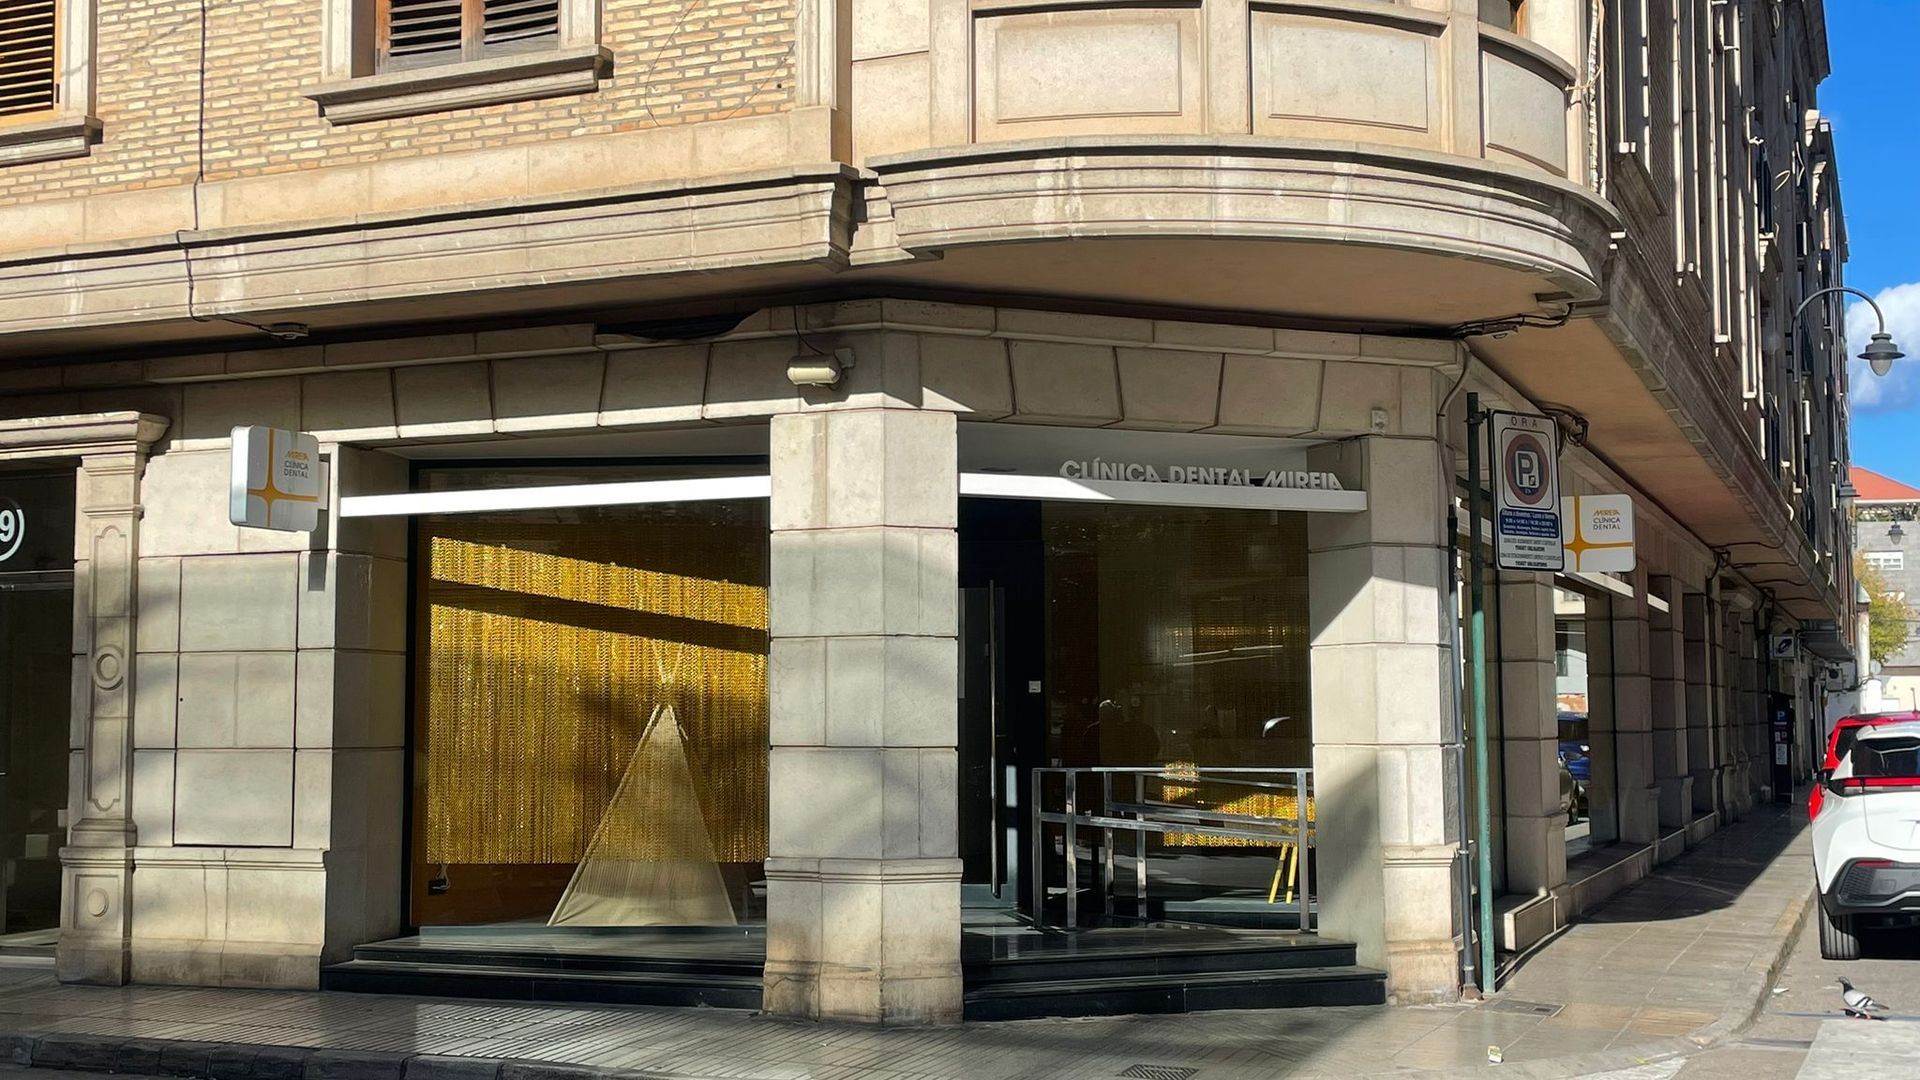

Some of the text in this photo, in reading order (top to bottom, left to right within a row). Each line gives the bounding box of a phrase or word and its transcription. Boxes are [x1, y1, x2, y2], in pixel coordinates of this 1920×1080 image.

[1511, 416, 1538, 428] ORA
[284, 469, 308, 478] DENTAL
[1060, 457, 1344, 490] CLÍNICA DENTAL MIREIA
[1593, 523, 1620, 531] DENTAL
